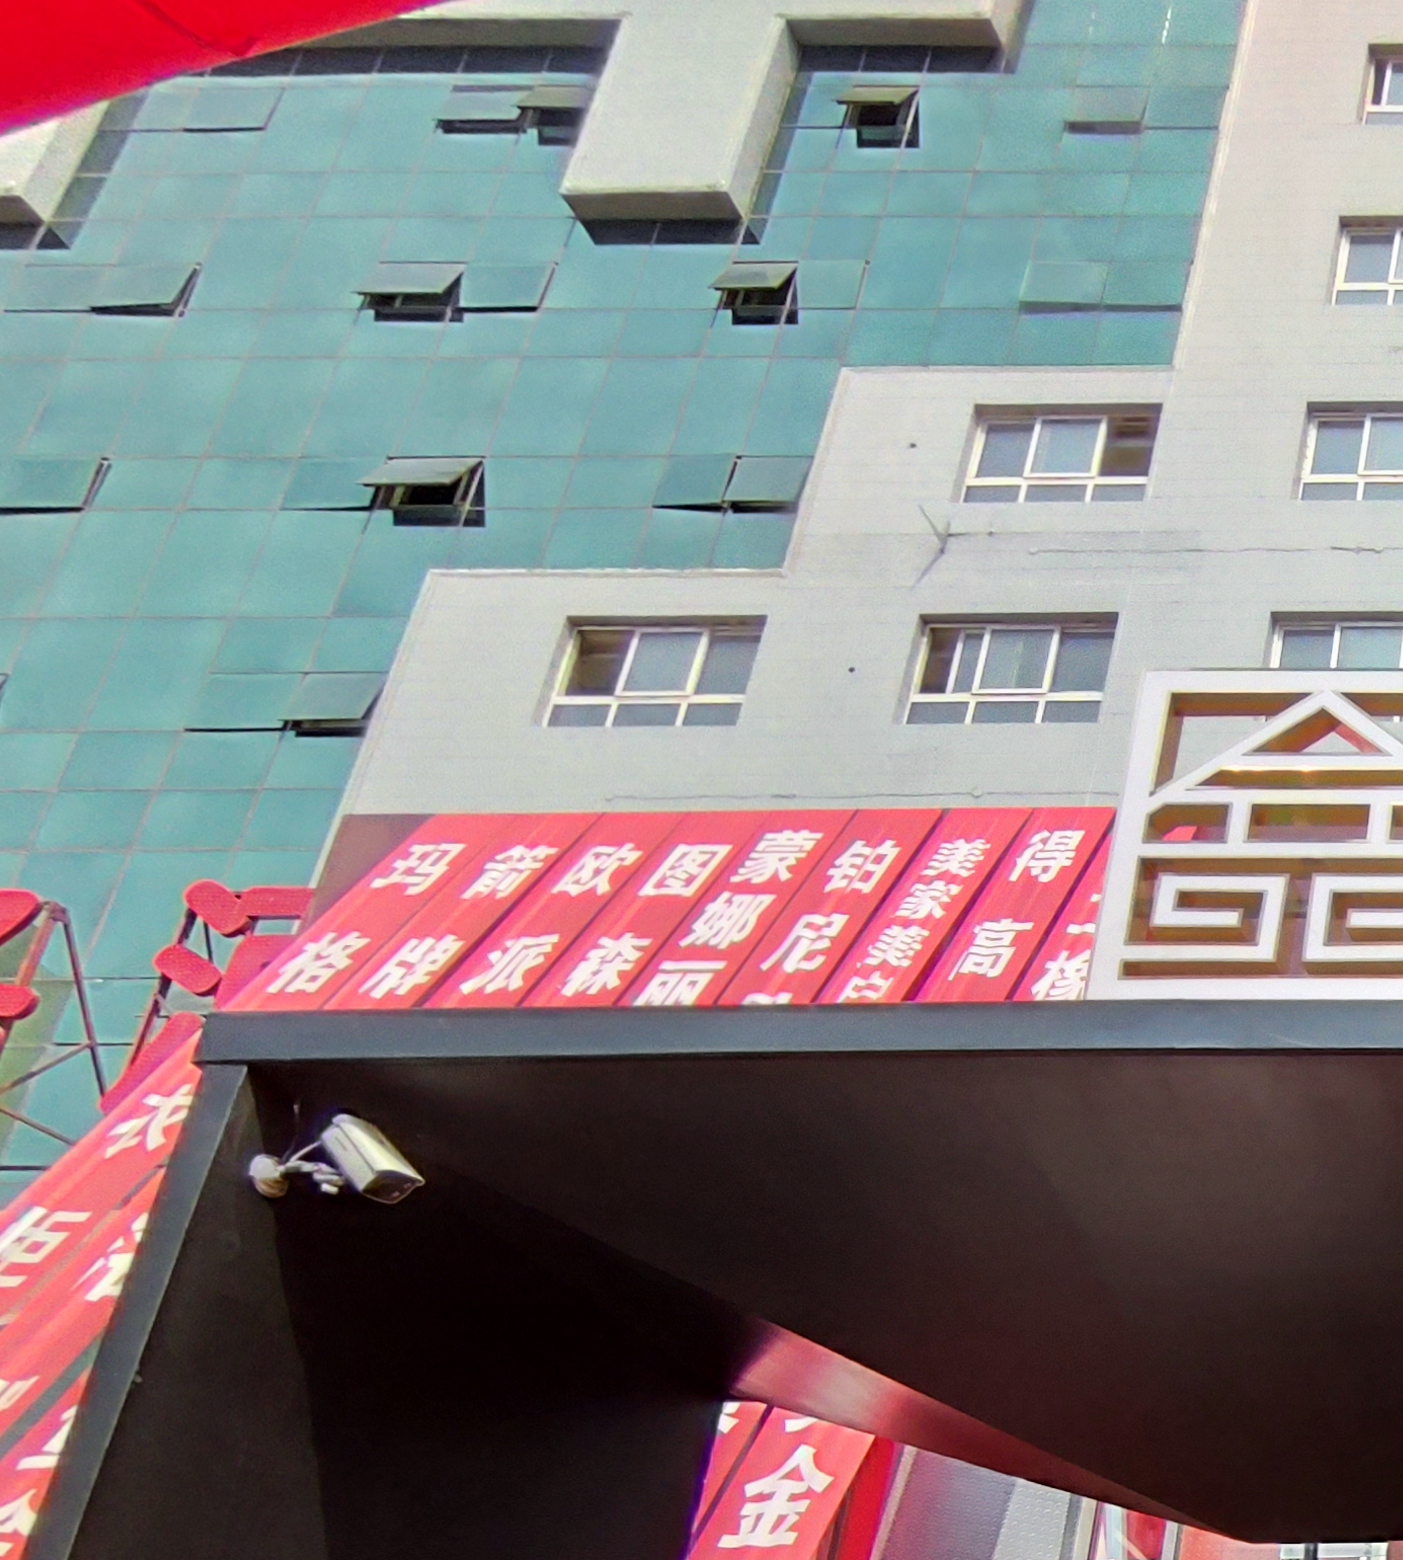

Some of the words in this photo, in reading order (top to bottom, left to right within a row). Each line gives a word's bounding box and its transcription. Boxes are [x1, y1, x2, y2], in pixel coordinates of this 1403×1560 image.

[266, 842, 467, 994] 玛格
[358, 844, 560, 999] 箭牌
[459, 842, 643, 995] 欧派
[559, 842, 733, 997] 图森
[742, 839, 902, 1005] 铂尼
[948, 829, 1086, 981] 得高
